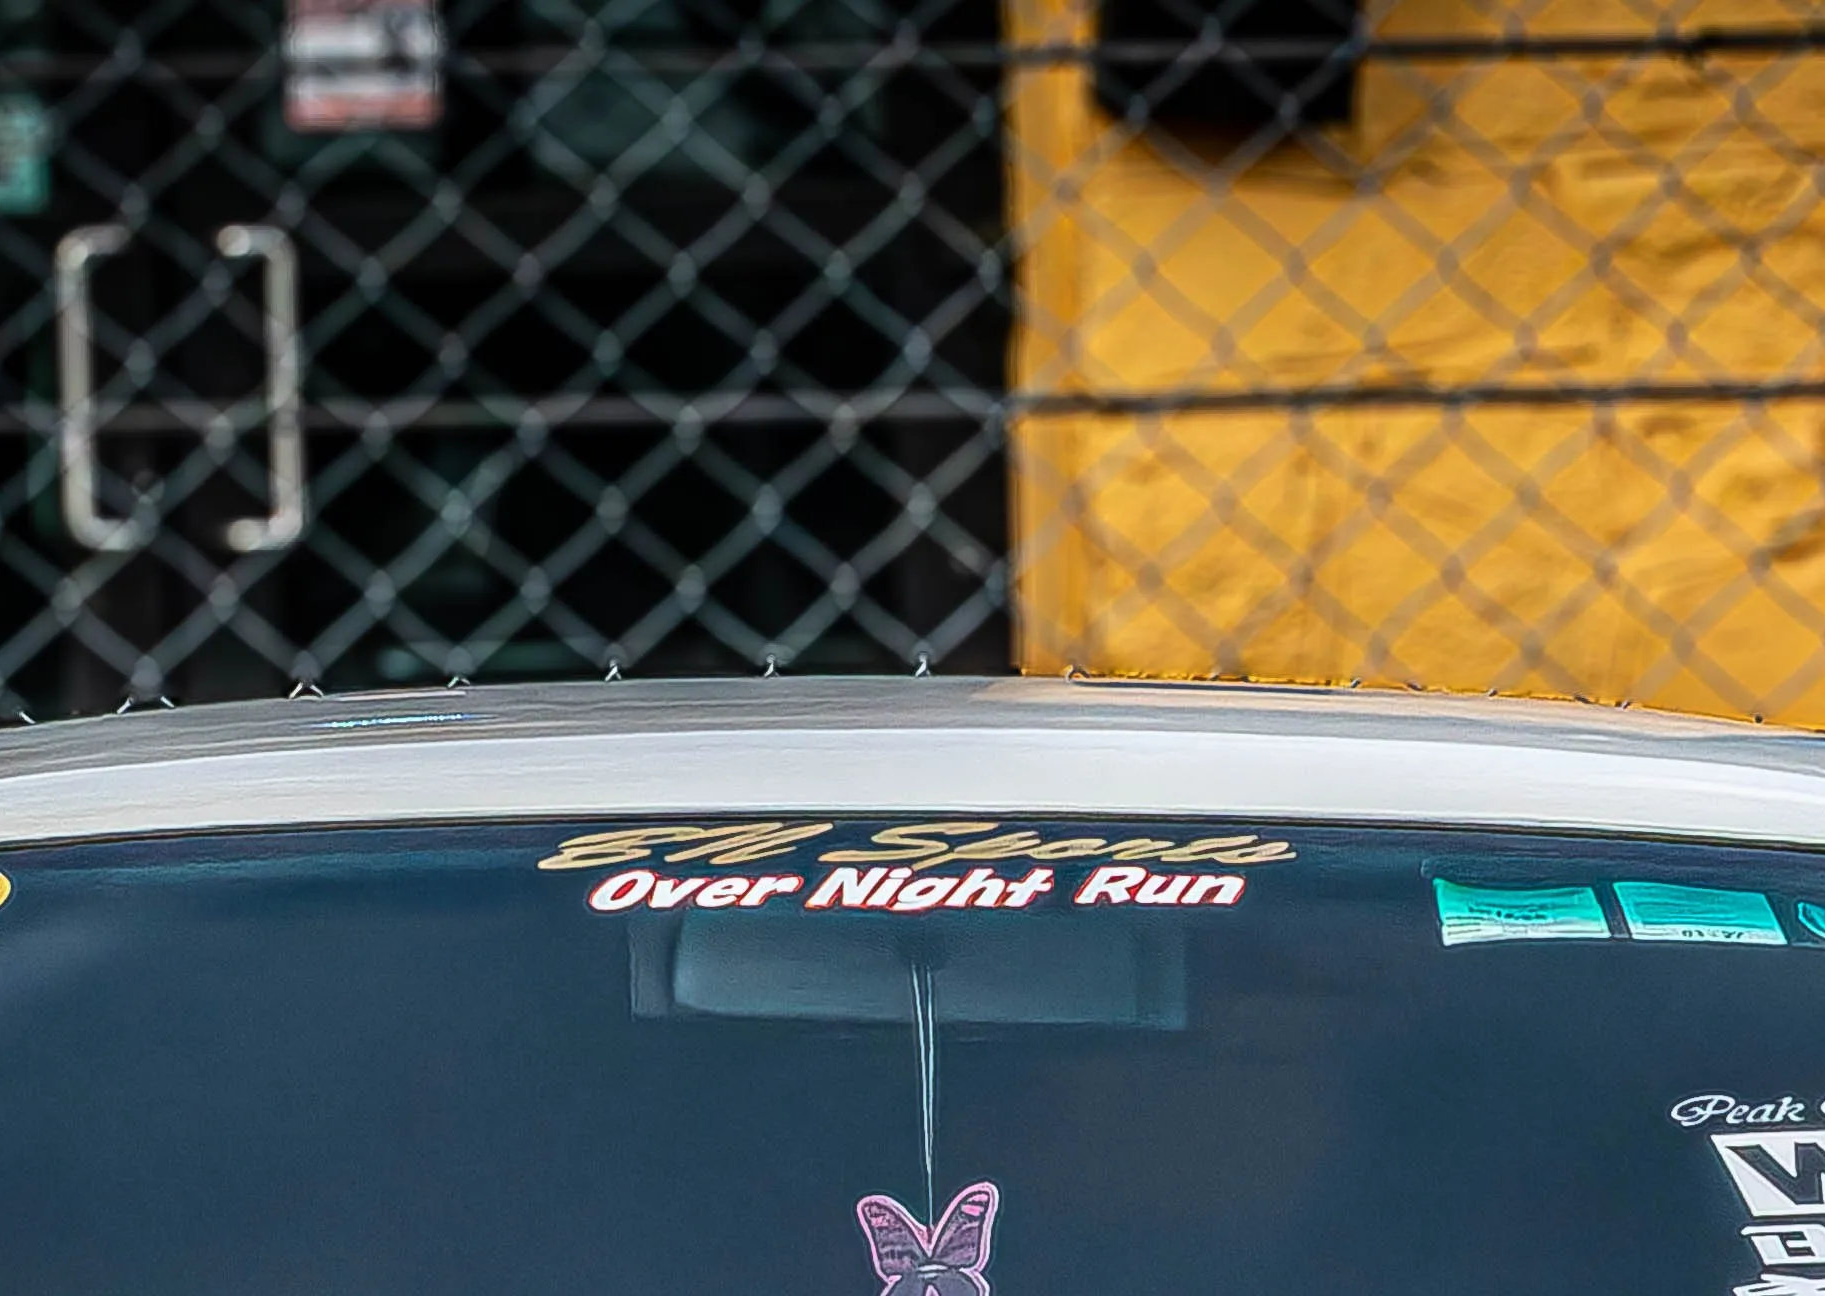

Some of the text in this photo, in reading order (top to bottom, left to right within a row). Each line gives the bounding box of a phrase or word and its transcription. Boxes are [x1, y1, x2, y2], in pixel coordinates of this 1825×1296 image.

[588, 866, 1246, 911] Over Night Run
[1670, 1094, 1806, 1127] Peak
